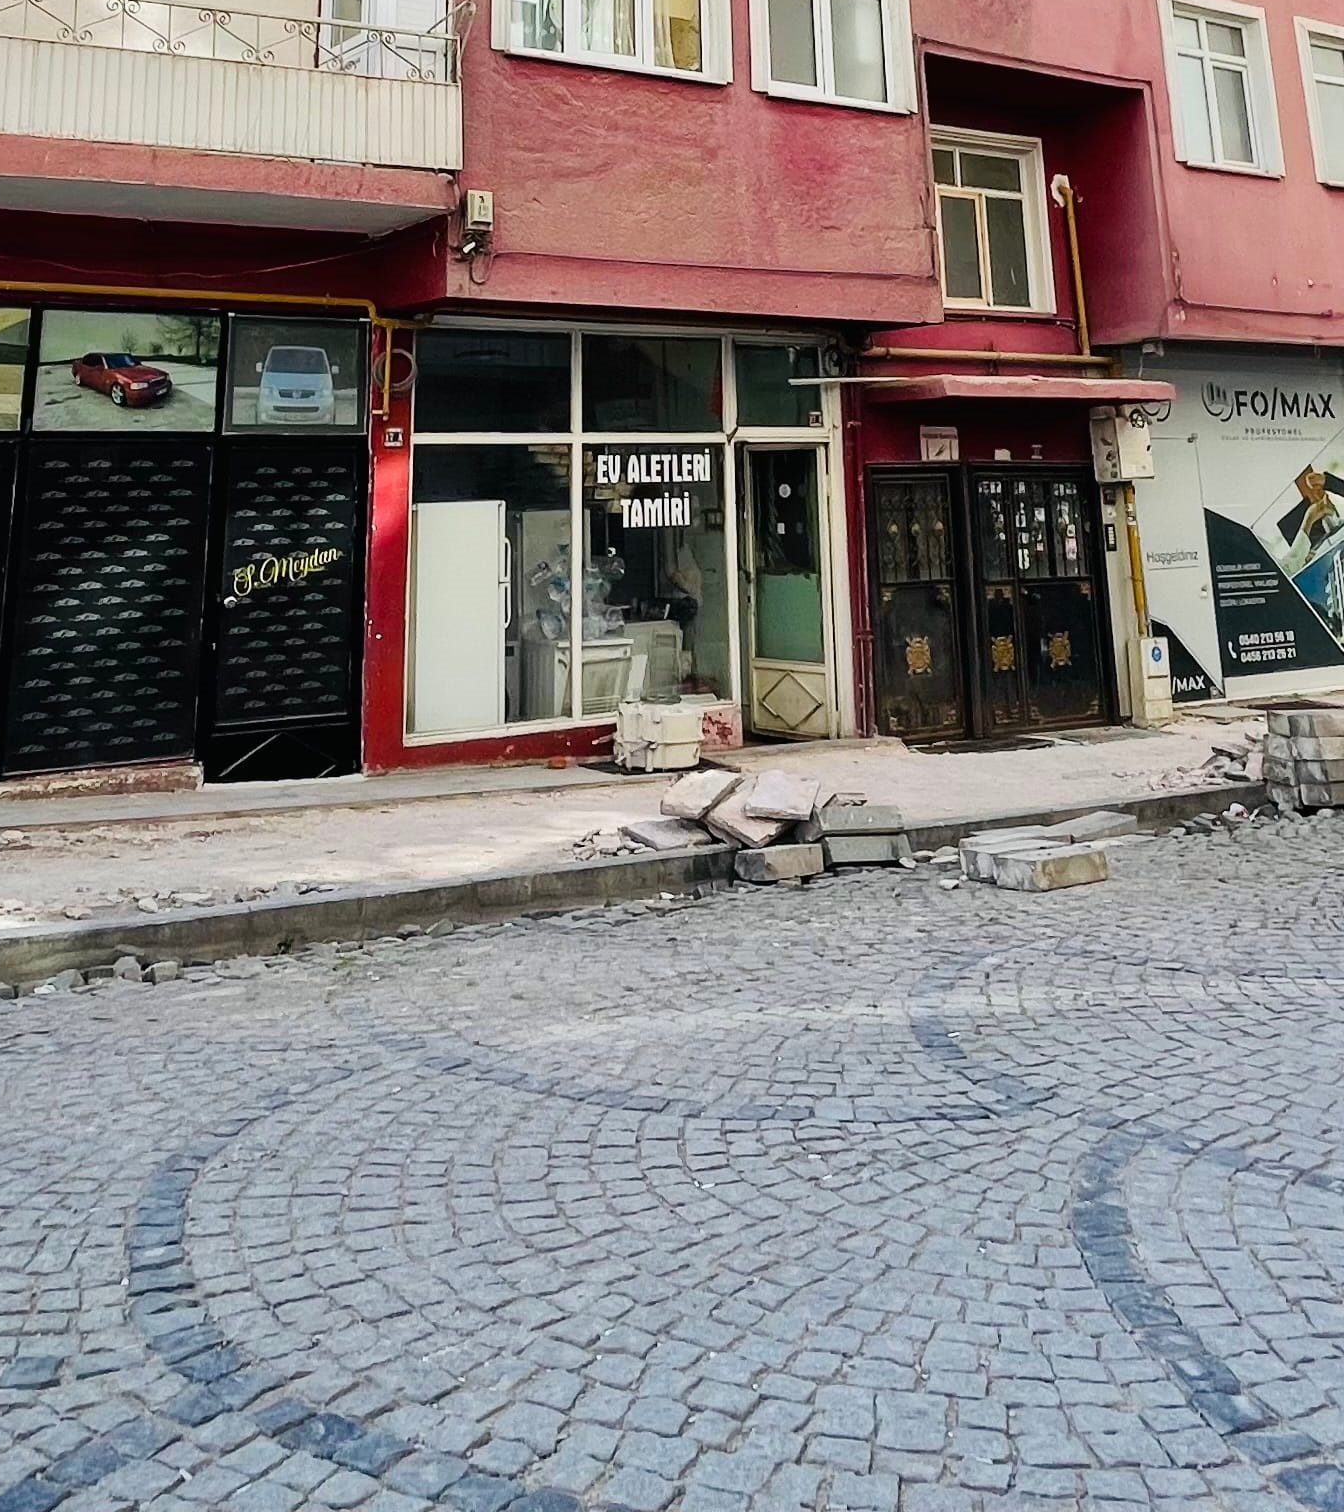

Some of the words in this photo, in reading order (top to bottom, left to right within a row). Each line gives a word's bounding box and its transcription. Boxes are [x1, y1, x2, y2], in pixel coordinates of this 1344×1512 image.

[597, 454, 621, 484] EV
[627, 448, 711, 483] ALETLERİ
[620, 491, 690, 528] TAMİRİ
